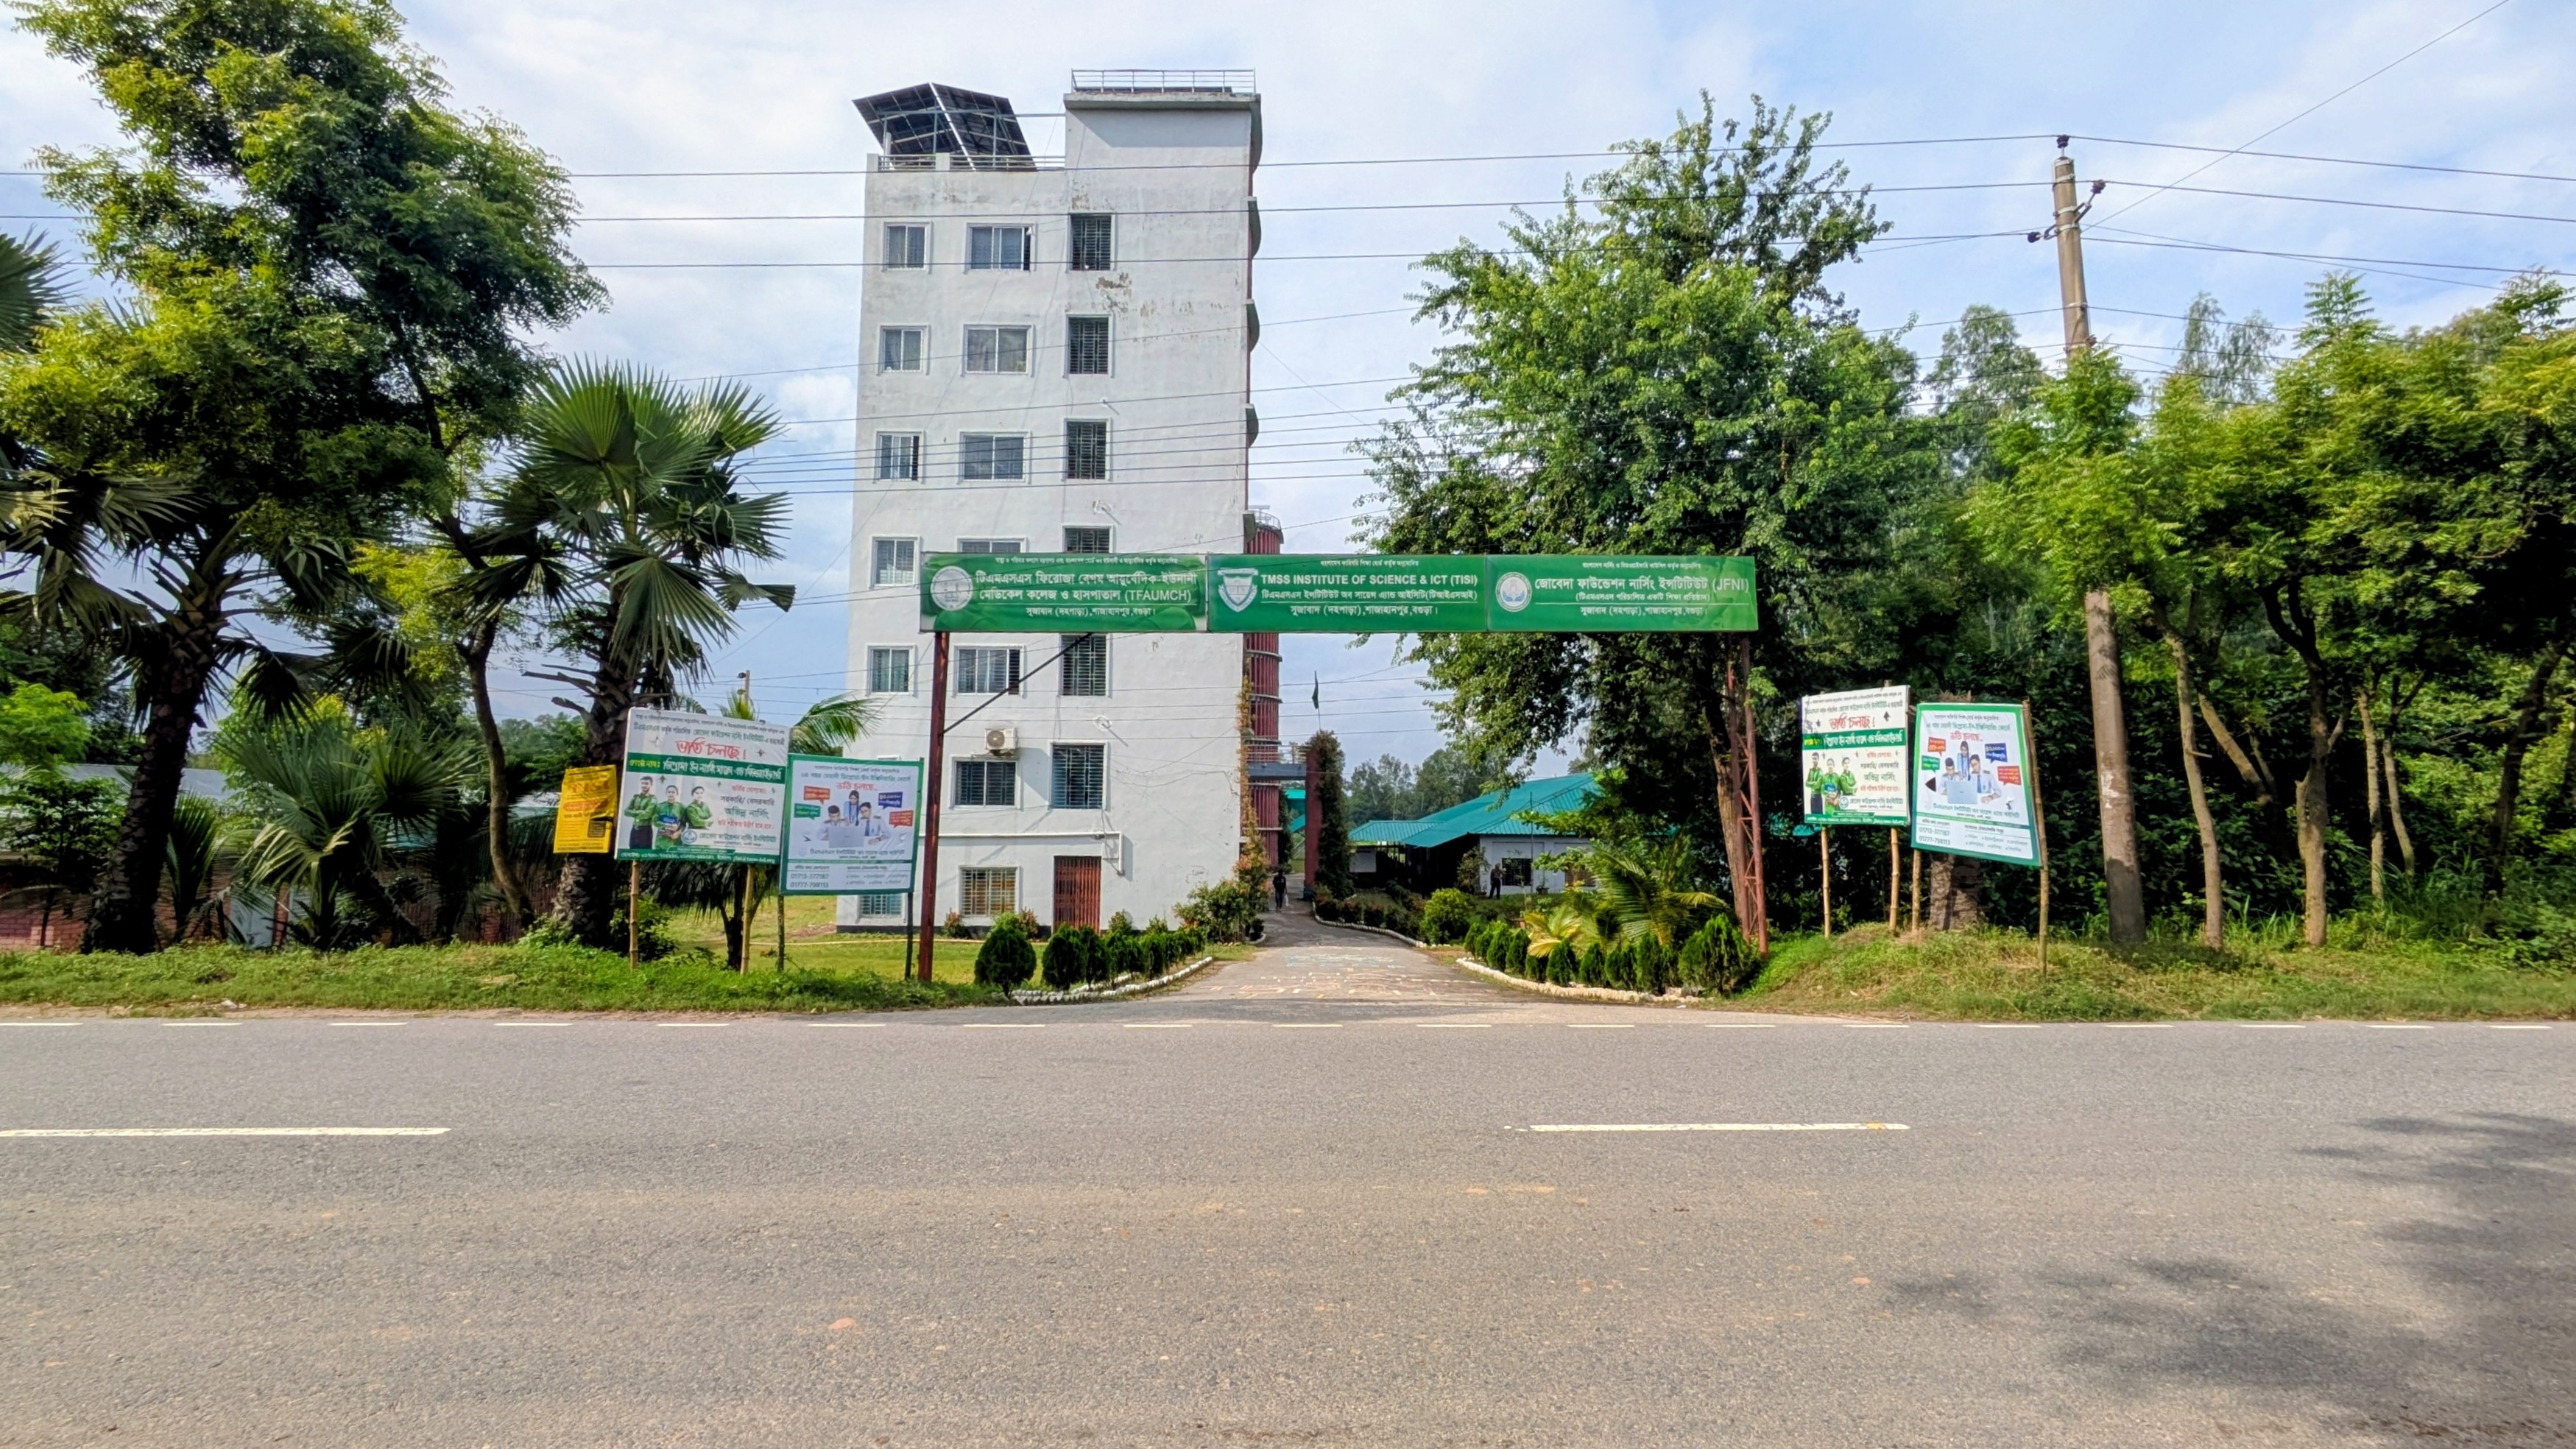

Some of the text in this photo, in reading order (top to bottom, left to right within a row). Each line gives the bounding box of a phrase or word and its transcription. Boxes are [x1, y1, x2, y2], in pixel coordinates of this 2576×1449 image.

[975, 570, 1032, 584] টিএমএসএস
[1036, 571, 1075, 584] ফিরোজা
[1079, 573, 1104, 585] বেগম
[1261, 574, 1478, 587] TMSS INSTITUTE OF SCIENCE & ICT (TISI)
[1535, 578, 1573, 590] জোবেদা
[1577, 576, 1626, 590] ফাউন্ডেশন
[1628, 575, 1656, 590] নার্সিং
[1712, 578, 1749, 593] (JFNI)
[979, 587, 1191, 603] মেডিকেল কলেজ ও হাসপাতাল (TFAUMCH)
[1261, 589, 1302, 599] টিএমএসএস
[1575, 591, 1614, 602] (টিএমএসএস
[1616, 591, 1645, 600] পরিচালিত
[1646, 592, 1664, 600] একটি
[1666, 592, 1682, 600] শিক্ষা
[1026, 607, 1053, 617] সুজাবাদ
[1290, 605, 1321, 616] সুজাবাদ
[1580, 607, 1607, 616] সুজাবাদ
[675, 737, 705, 754] ভর্তি
[747, 797, 774, 805] বেসরকারি
[749, 808, 769, 819] নার্সিং
